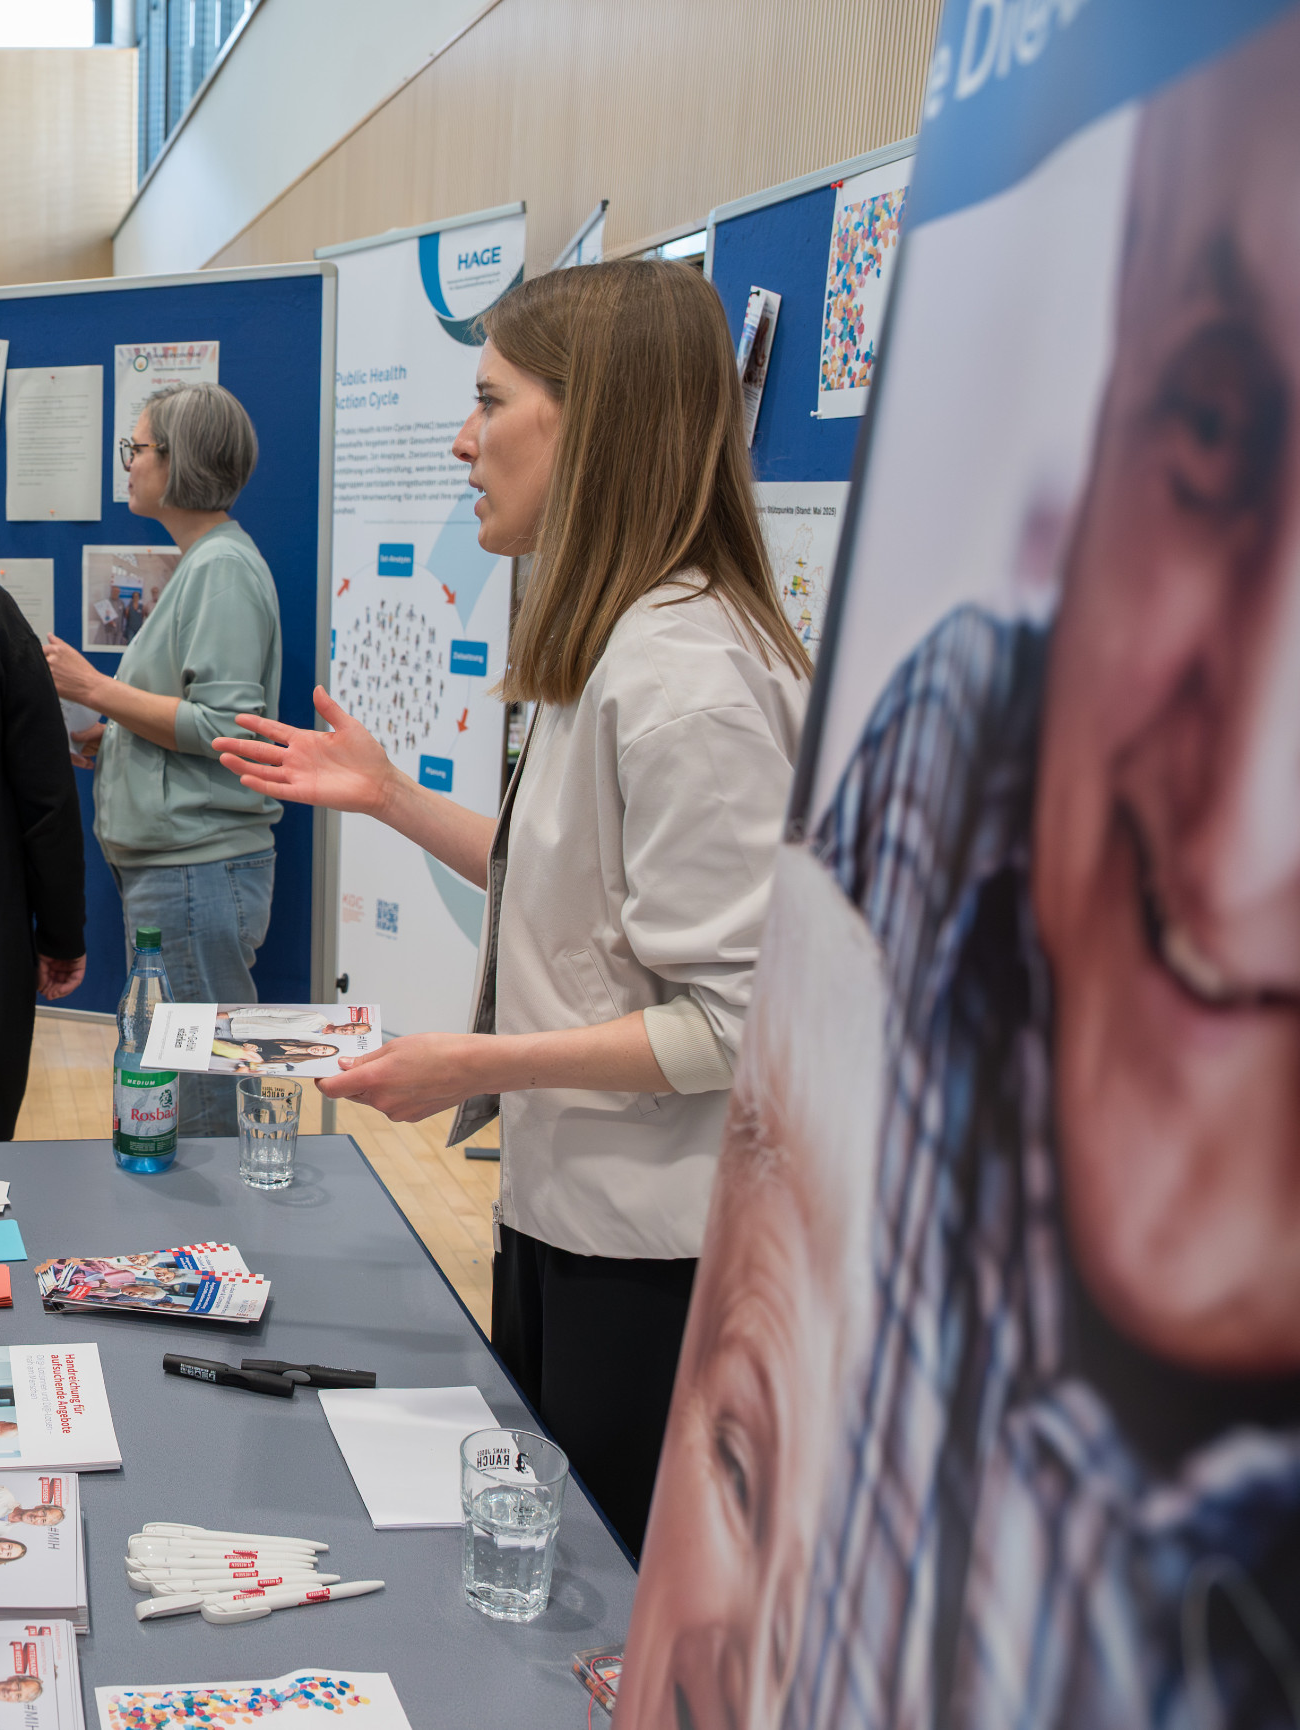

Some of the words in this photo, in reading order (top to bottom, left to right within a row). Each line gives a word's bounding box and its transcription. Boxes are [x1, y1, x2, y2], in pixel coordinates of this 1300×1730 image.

[457, 245, 502, 271] HAGE
[336, 369, 367, 387] Public
[369, 364, 407, 384] Health
[369, 390, 399, 410] Cycle
[449, 463, 471, 471] betroffe
[767, 506, 793, 515] Stützpunkte
[794, 506, 811, 516] (Stand:
[813, 507, 821, 515] Mai
[822, 507, 836, 517] 2025)
[29, 1375, 37, 1399] Menschen
[51, 1354, 67, 1399] aufsuchende
[65, 1354, 81, 1403] Handreichung
[73, 1404, 85, 1414] für
[56, 1401, 72, 1433] Angebote
[48, 1525, 60, 1549] #MIH
[15, 1651, 23, 1672] HESSEN
[29, 1645, 37, 1677] MITEINAND
